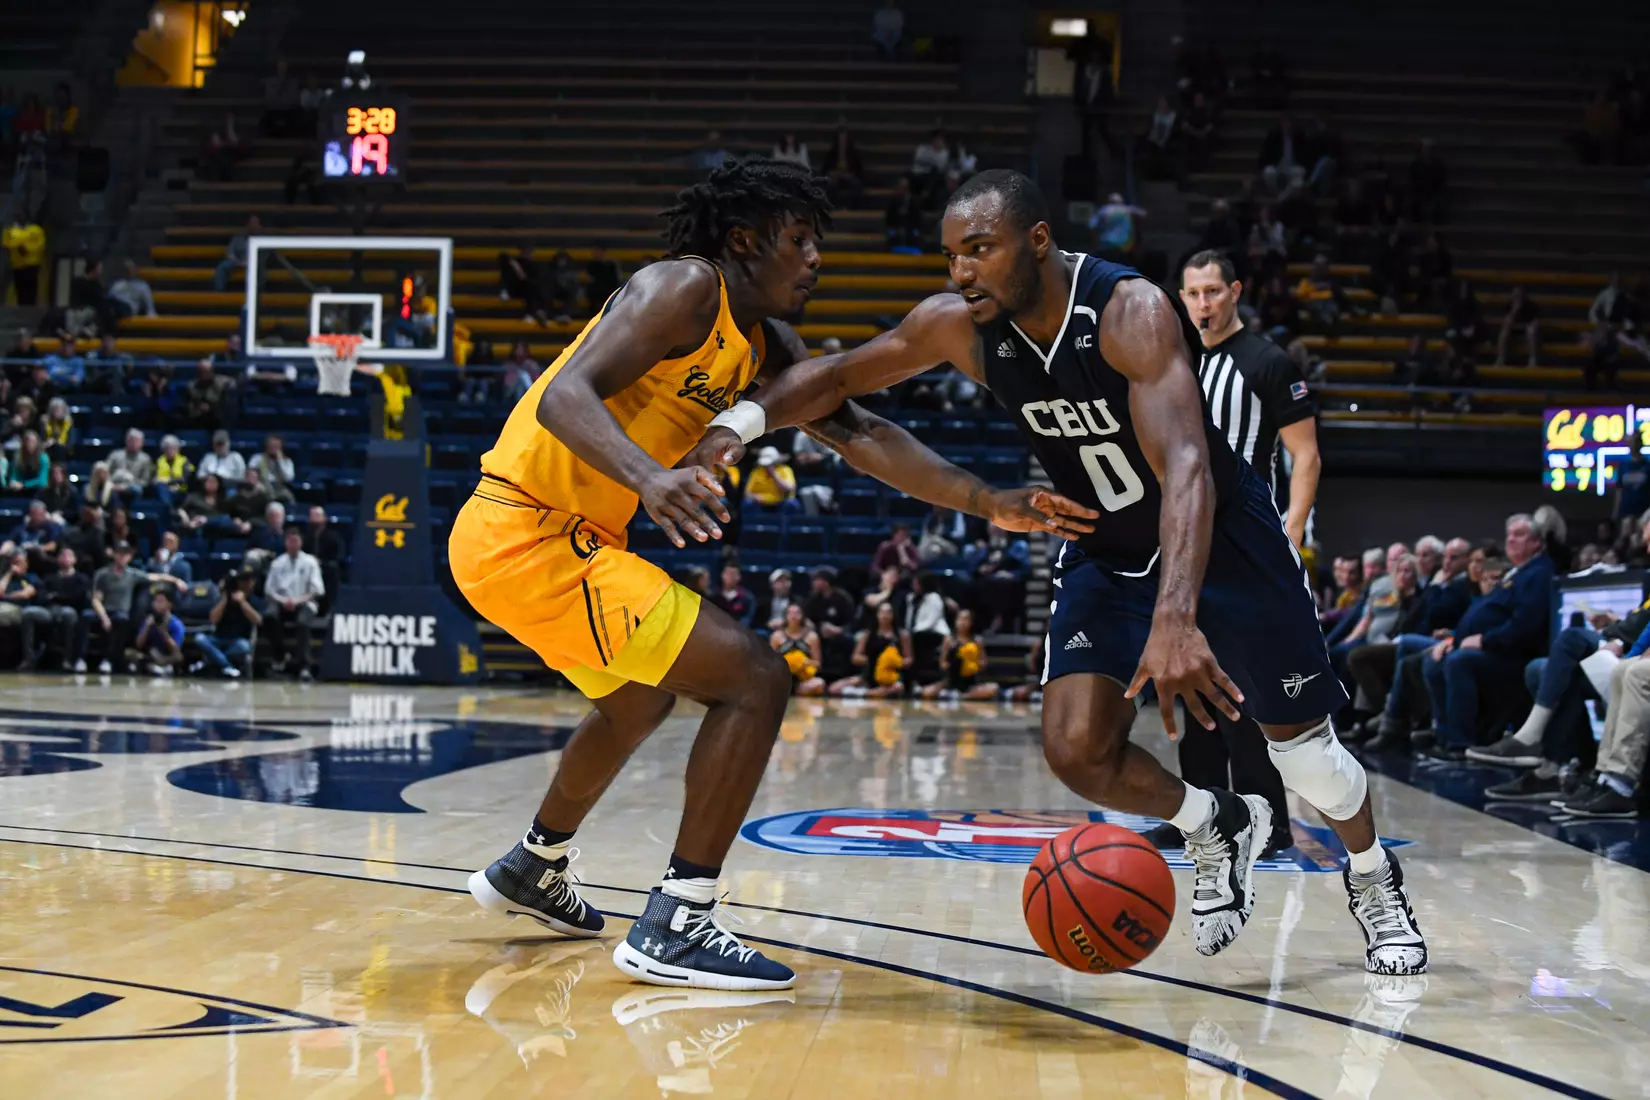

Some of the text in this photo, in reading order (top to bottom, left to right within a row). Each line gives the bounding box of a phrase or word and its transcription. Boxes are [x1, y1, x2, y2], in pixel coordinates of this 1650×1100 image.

[351, 134, 388, 175] 19
[1021, 398, 1121, 437] CBU
[1079, 442, 1144, 512] 0
[375, 493, 409, 521] Cal
[333, 614, 436, 646] MUSCLE
[1064, 640, 1093, 650] adidas
[352, 645, 416, 675] MILK
